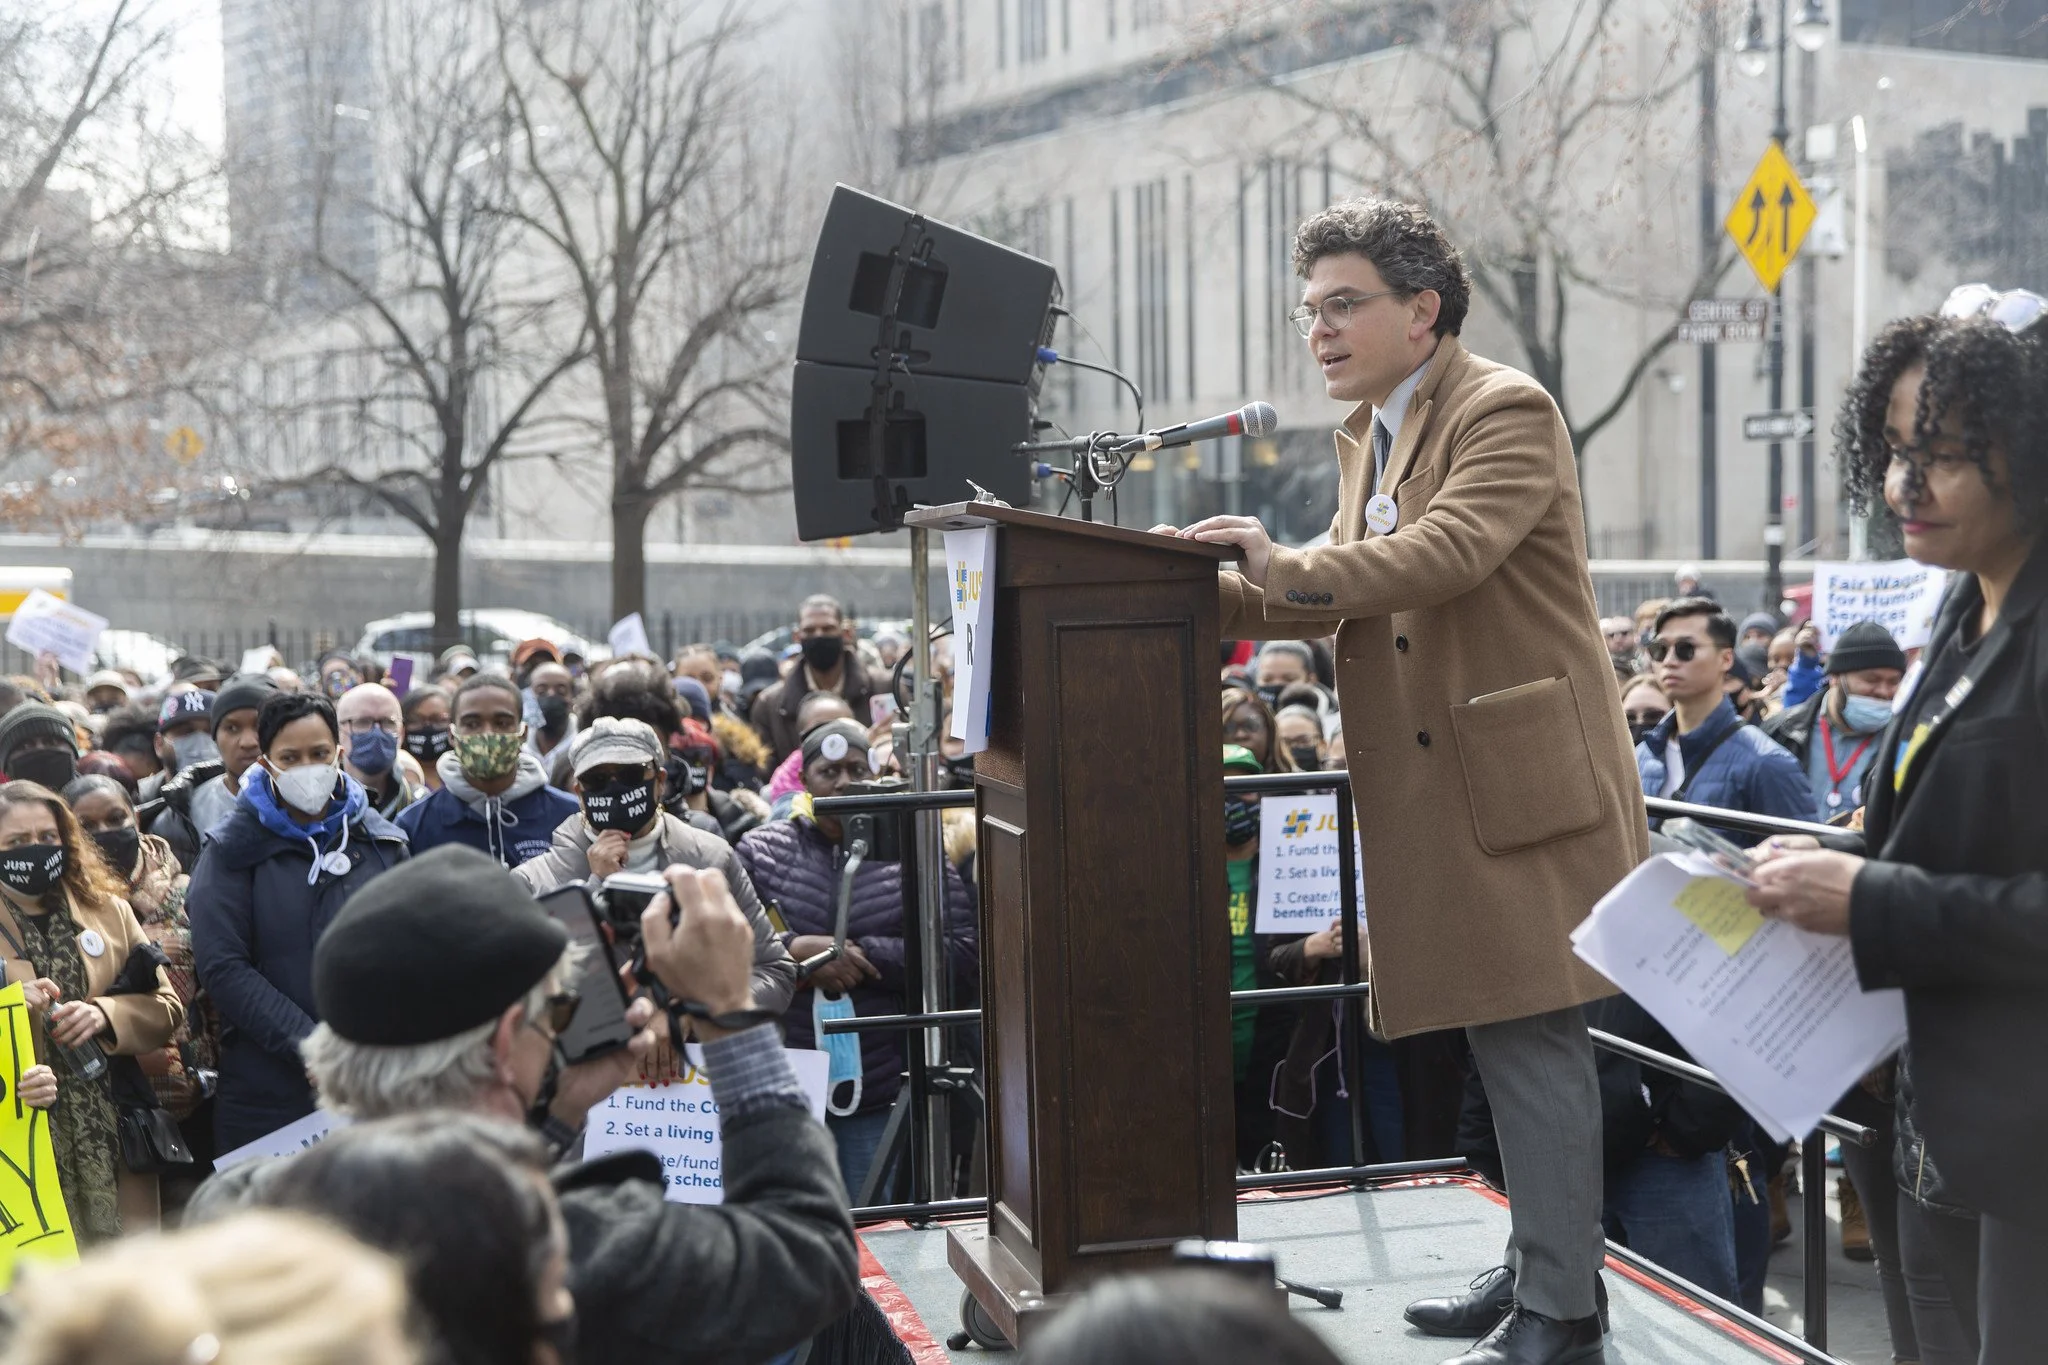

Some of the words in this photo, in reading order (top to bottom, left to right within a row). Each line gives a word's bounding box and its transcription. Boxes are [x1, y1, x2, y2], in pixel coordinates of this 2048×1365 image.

[1828, 575, 1864, 590] Fair
[1873, 571, 1929, 590] Wages
[1863, 588, 1925, 606] Human
[1827, 608, 1906, 621] Services
[587, 796, 613, 807] JUST
[620, 786, 647, 804] JUST
[592, 812, 609, 822] PAY
[628, 801, 647, 818] PAY
[1288, 844, 1318, 857] Fund
[1323, 843, 1338, 855] th
[4, 860, 34, 872] JUST
[44, 849, 62, 871] JUST
[9, 873, 30, 884] PAY
[49, 864, 62, 882] PAY
[1288, 867, 1307, 879] Set
[1311, 869, 1318, 877] a
[1273, 906, 1324, 918] benefits
[608, 1096, 620, 1109] 1.
[625, 1096, 665, 1111] Fund
[670, 1099, 696, 1113] the
[606, 1121, 619, 1135] 2.
[624, 1122, 649, 1136] Set
[654, 1127, 663, 1137] a
[668, 1125, 714, 1143] living
